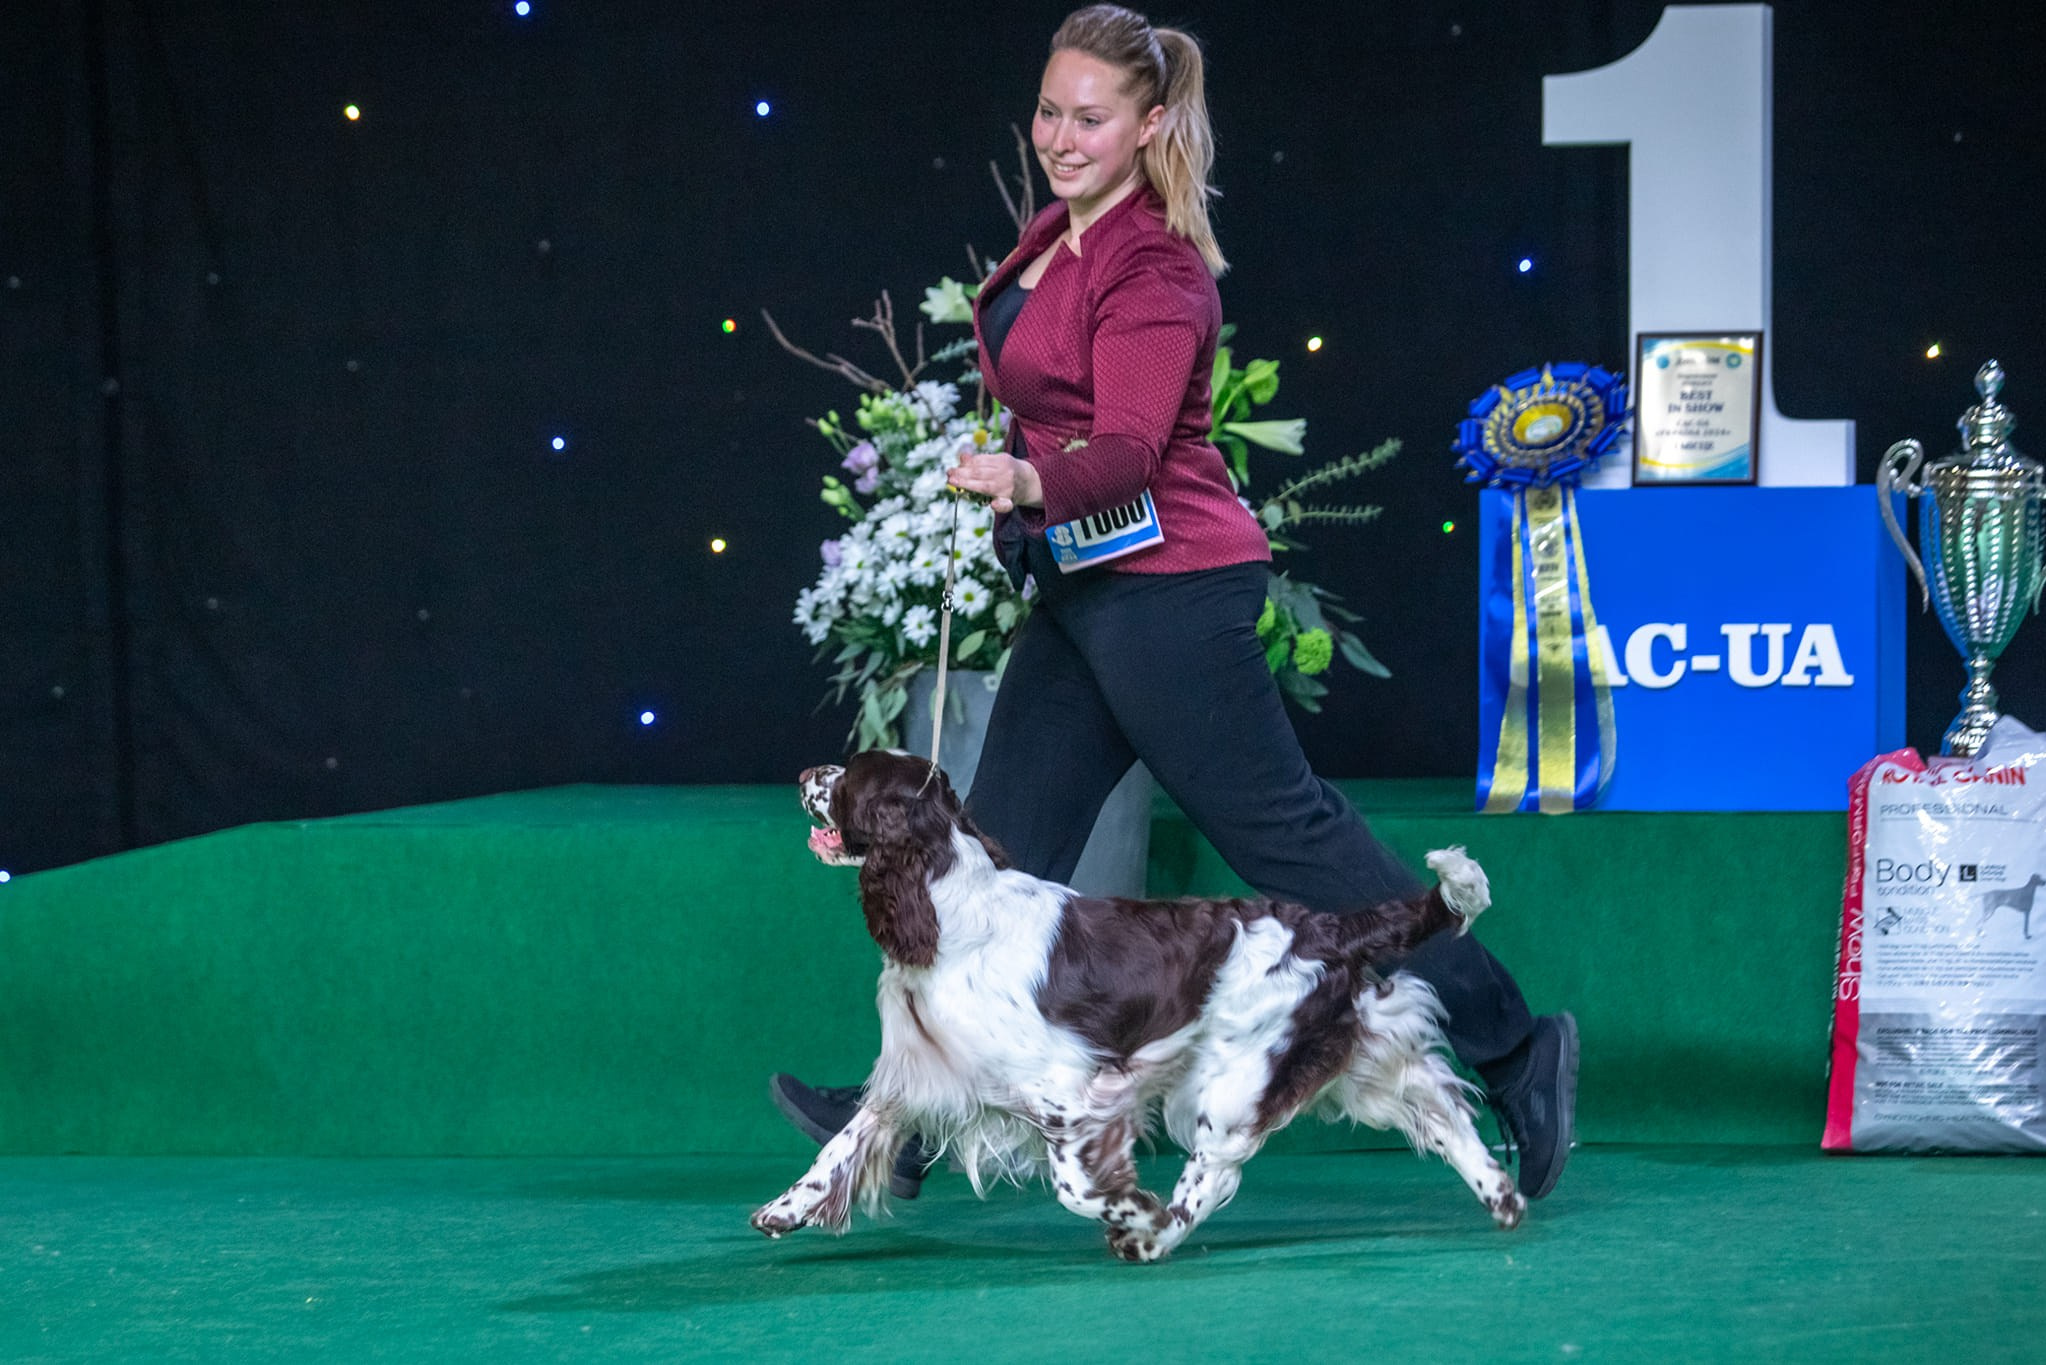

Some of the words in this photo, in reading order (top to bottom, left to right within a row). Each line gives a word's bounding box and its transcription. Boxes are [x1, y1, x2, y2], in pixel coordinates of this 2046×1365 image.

[1542, 3, 1856, 488] 1
[1667, 403, 1682, 414] IN
[1685, 402, 1725, 414] SHOW
[1879, 803, 2010, 816] PROFESSIONAL
[1876, 858, 1952, 887] Body
[1876, 885, 1936, 896] condition
[1839, 907, 1864, 1002] Show
